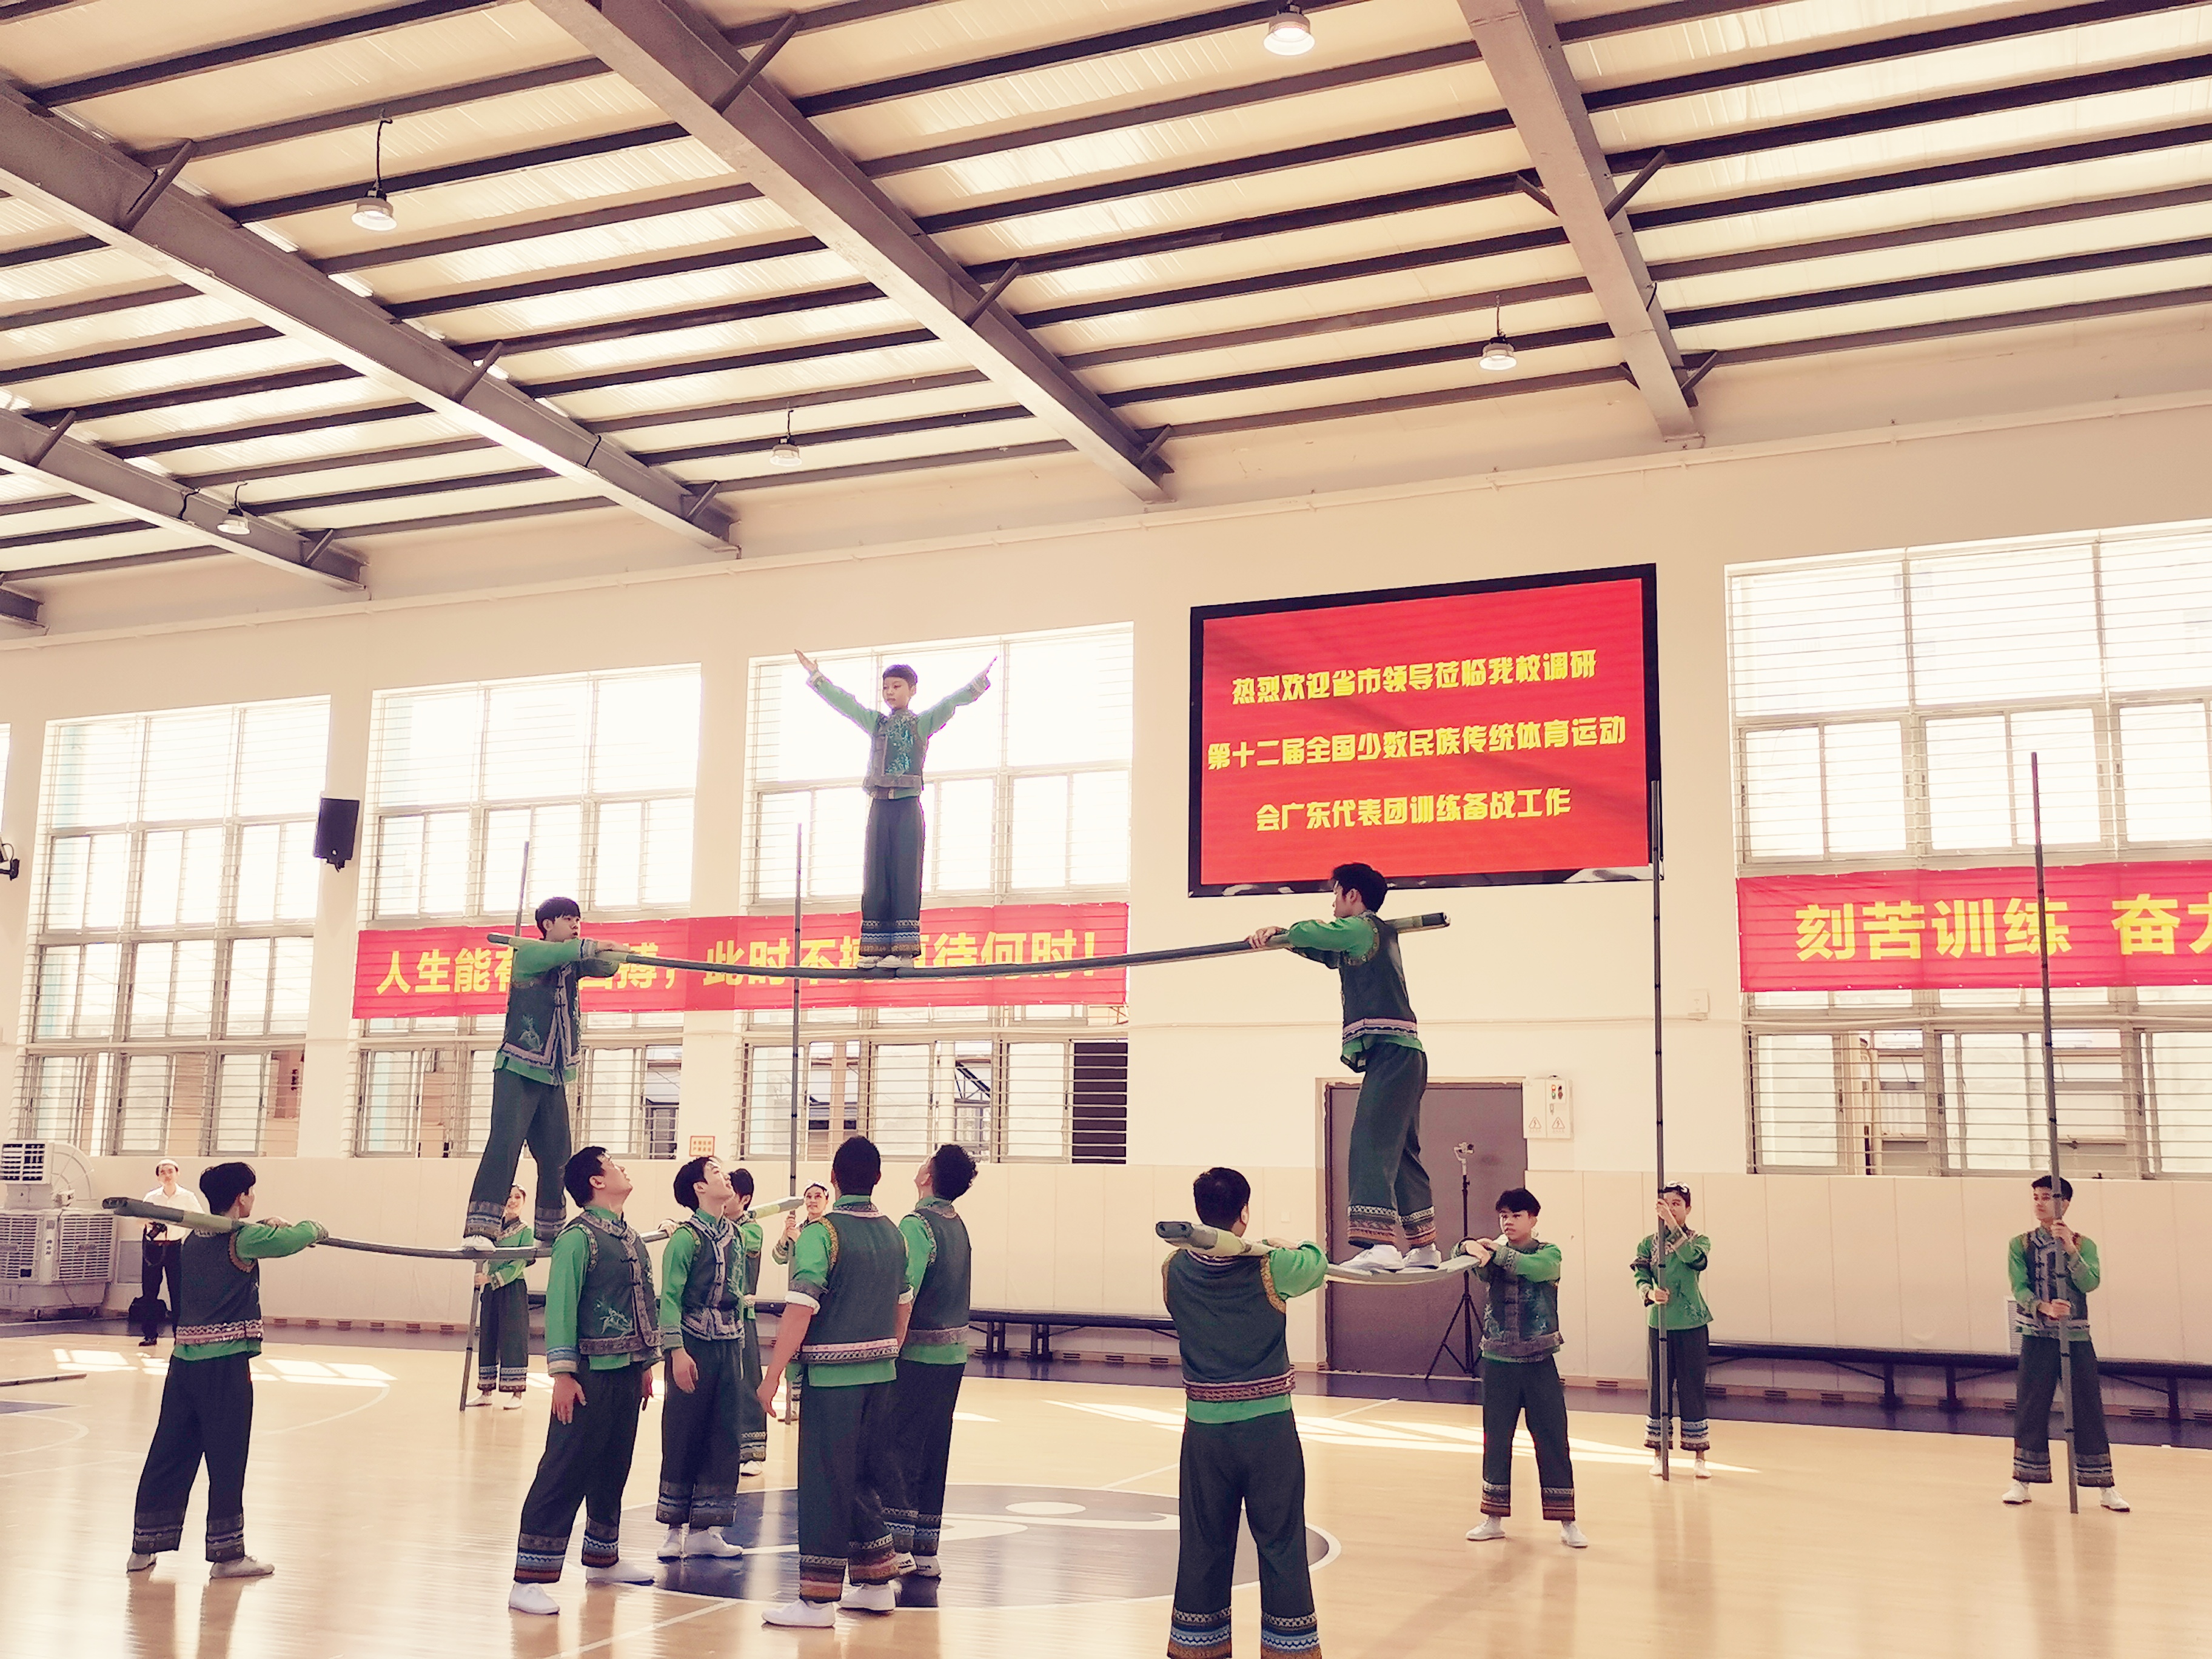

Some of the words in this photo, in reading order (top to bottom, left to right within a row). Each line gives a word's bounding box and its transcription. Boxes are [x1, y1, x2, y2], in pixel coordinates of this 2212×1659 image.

[1232, 649, 1597, 705] 热烈欢迎省市领导莅临我校调研
[1207, 715, 1626, 771] 第十二届全国少数民族传统体育运动
[1256, 787, 1572, 831] 会广东代表团训练备战工作
[1795, 897, 2073, 962] 刻苦训练
